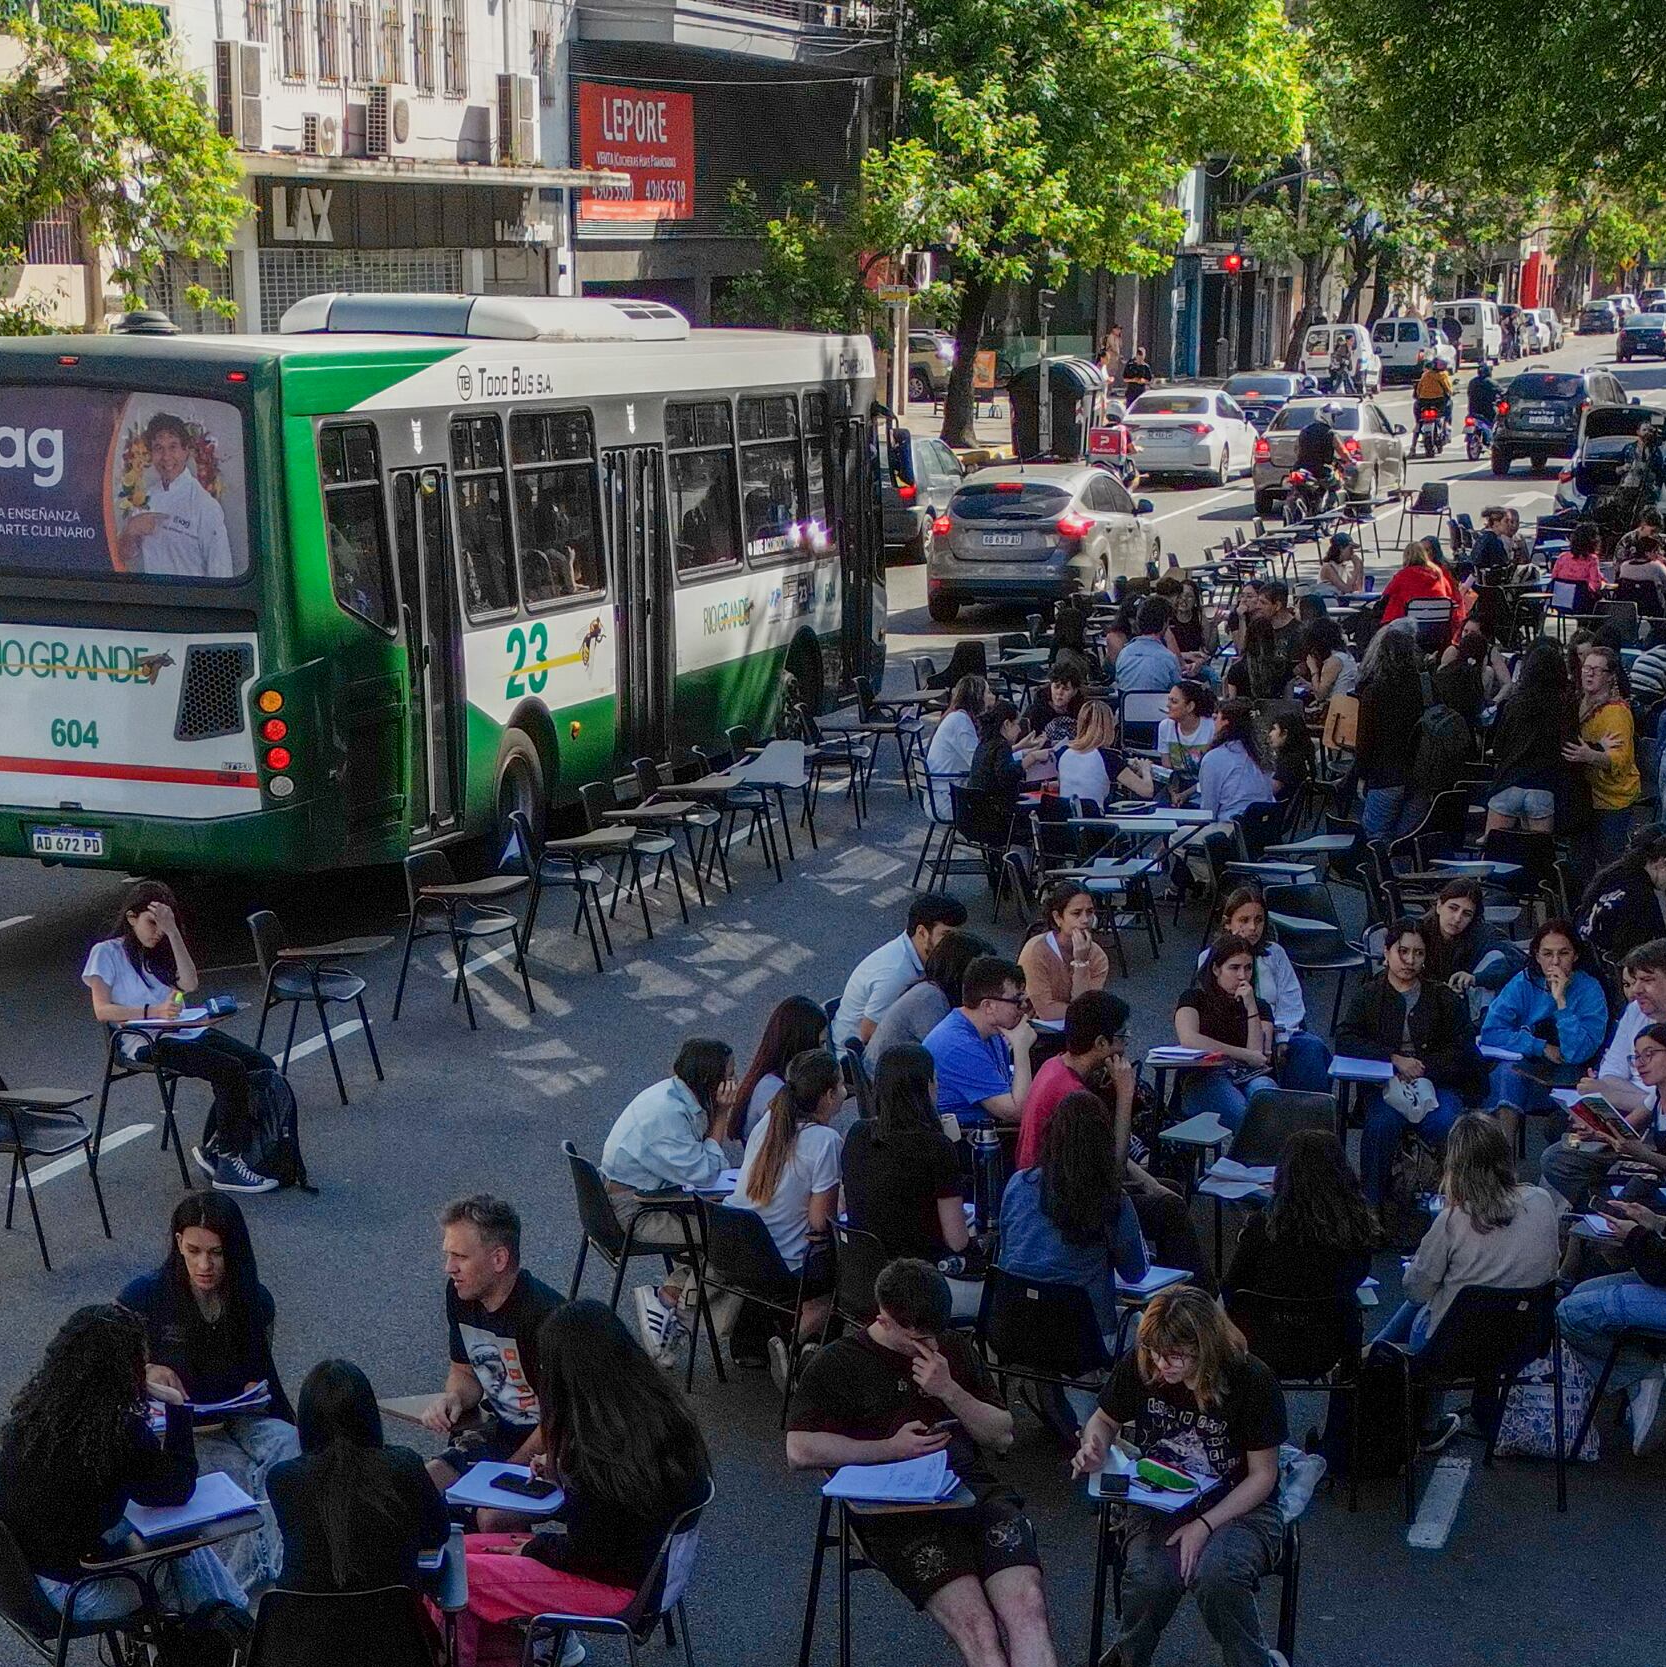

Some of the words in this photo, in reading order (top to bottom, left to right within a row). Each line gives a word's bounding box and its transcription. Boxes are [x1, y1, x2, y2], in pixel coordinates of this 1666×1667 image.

[603, 97, 668, 143] LEPORE
[272, 186, 334, 241] LAX
[8, 507, 81, 522] ENSEÑANZA
[30, 525, 96, 539] CULINARIO
[29, 640, 150, 685] GRANDE
[505, 622, 548, 700] 23
[51, 718, 99, 749] 604
[36, 836, 52, 850] AD
[56, 837, 80, 852] 672
[84, 838, 100, 853] PD
